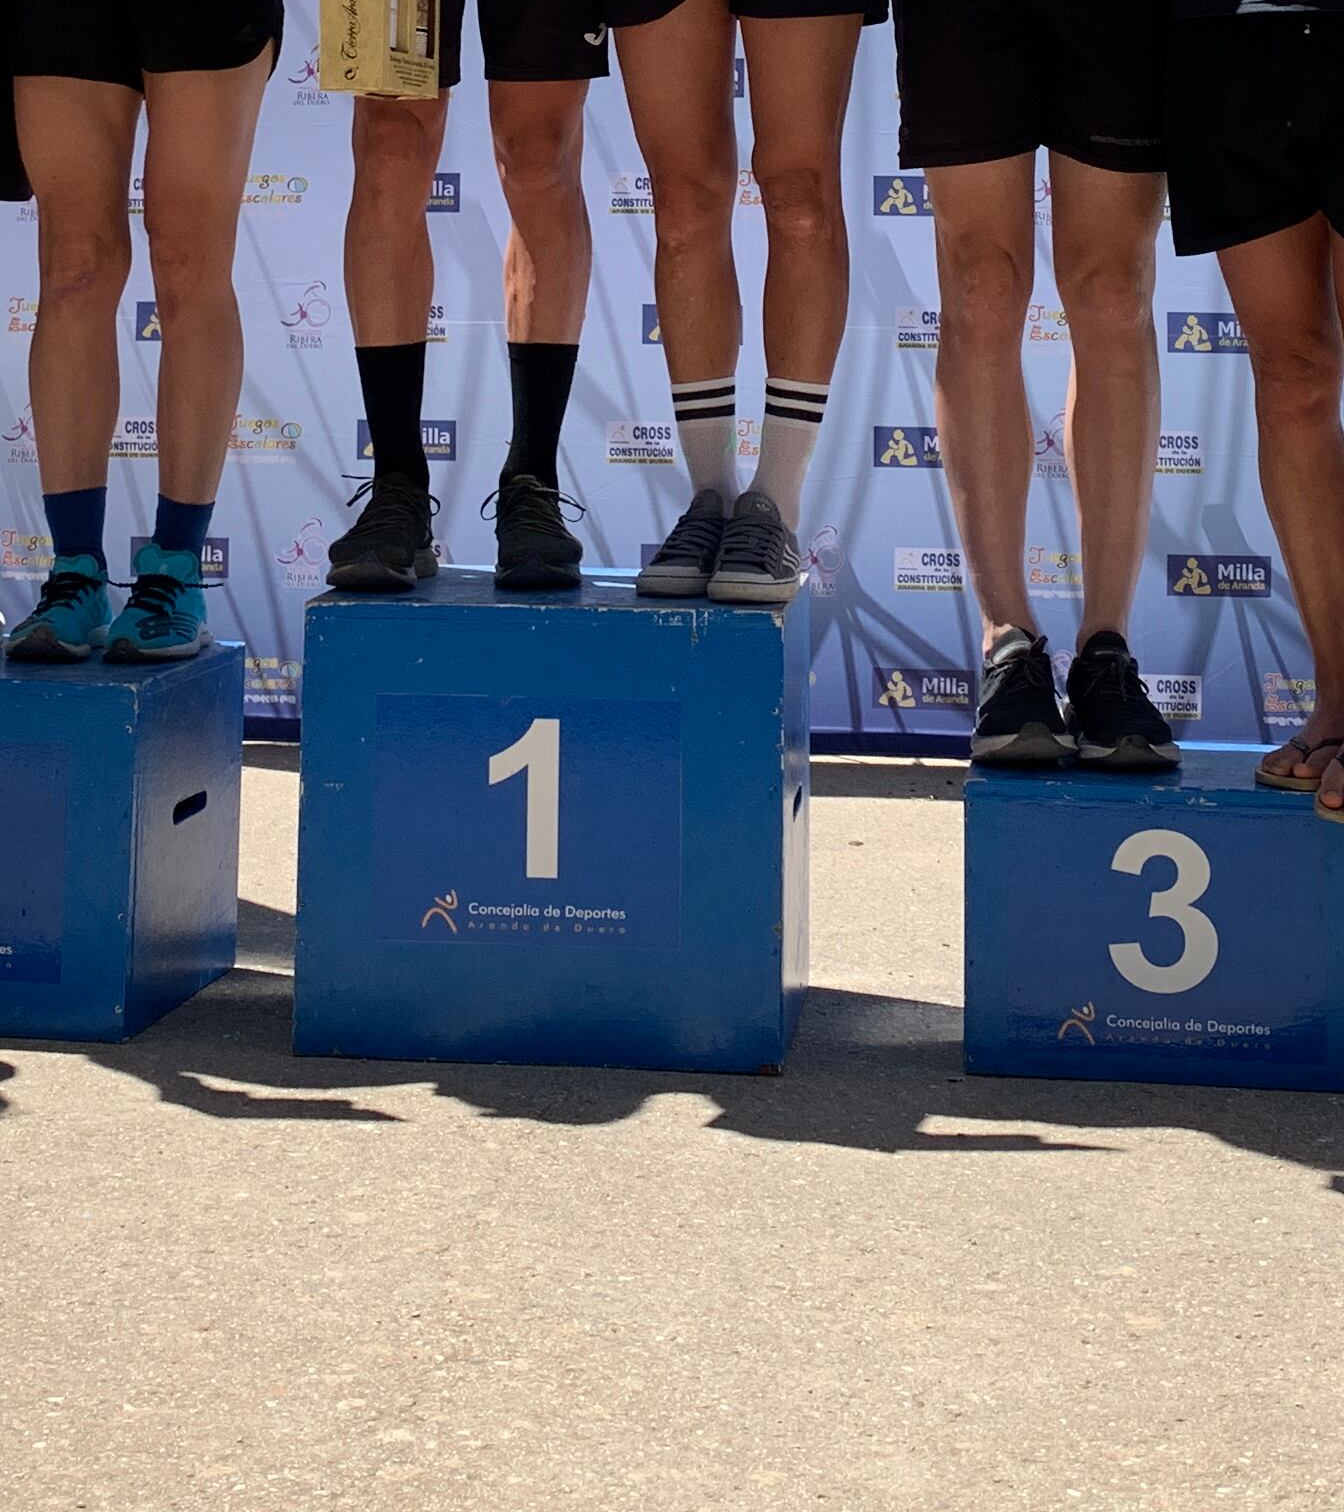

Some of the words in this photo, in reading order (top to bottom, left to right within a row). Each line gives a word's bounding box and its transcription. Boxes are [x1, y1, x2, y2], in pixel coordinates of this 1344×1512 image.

[433, 180, 455, 197] lla
[240, 190, 302, 204] scolares
[611, 197, 655, 208] CONSTITU
[125, 420, 155, 434] CROS
[633, 426, 671, 440] CROSS
[422, 426, 451, 445] illa
[1159, 434, 1199, 450] CROSS
[609, 446, 673, 458] CONSTITUCIÓN
[201, 546, 223, 562] lla
[921, 552, 960, 568] CROSS
[897, 571, 962, 585] CONSTITUCIÓN
[1218, 562, 1266, 582] Milla
[1231, 580, 1266, 591] Aranda
[922, 676, 969, 695] Milla
[1157, 678, 1196, 694] CROSS
[937, 694, 969, 705] Aranda
[1156, 698, 1199, 712] TITUCIÓN
[488, 718, 561, 879] 1
[544, 905, 561, 917] de
[565, 905, 626, 920] Deportes
[1108, 828, 1219, 994] 3
[1184, 1018, 1203, 1032] de
[1207, 1020, 1271, 1036] Deportes
